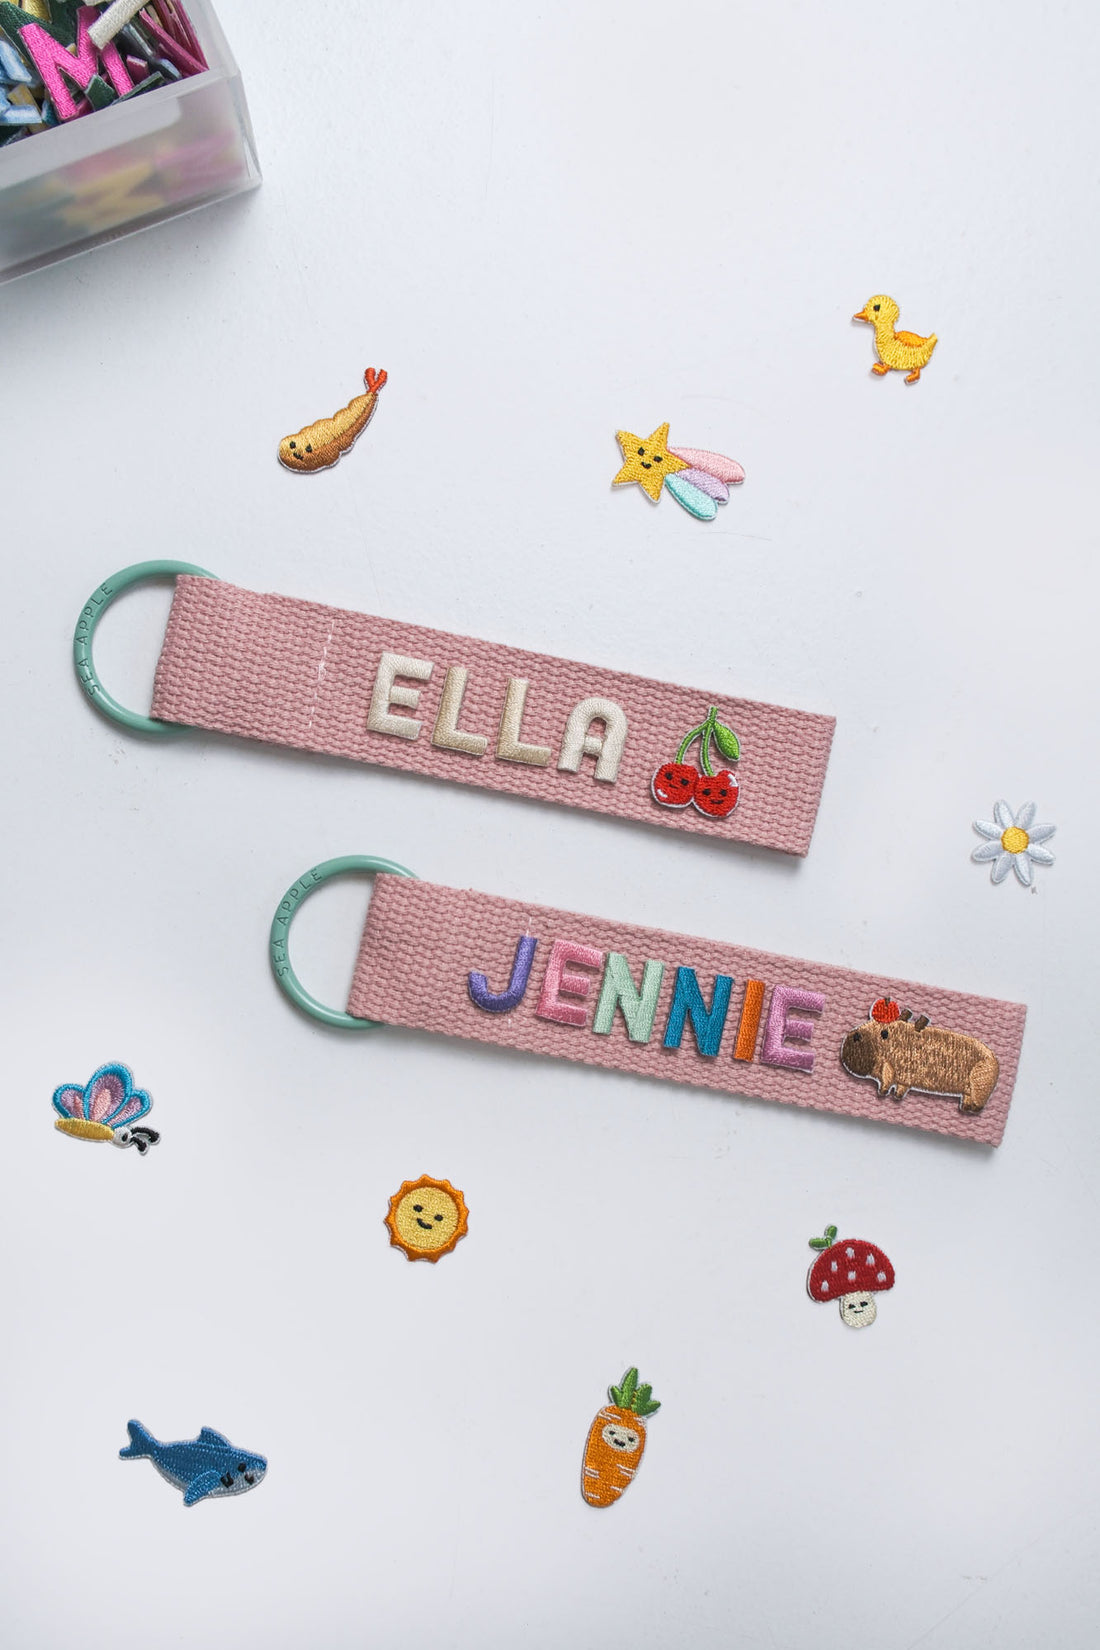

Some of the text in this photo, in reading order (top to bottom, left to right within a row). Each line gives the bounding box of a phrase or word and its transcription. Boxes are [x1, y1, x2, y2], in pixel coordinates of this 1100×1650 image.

[75, 582, 113, 696] SEA APPLE
[366, 651, 629, 784] ELLA
[272, 868, 322, 977] SEA APPLE
[467, 935, 825, 1074] JENNIE
